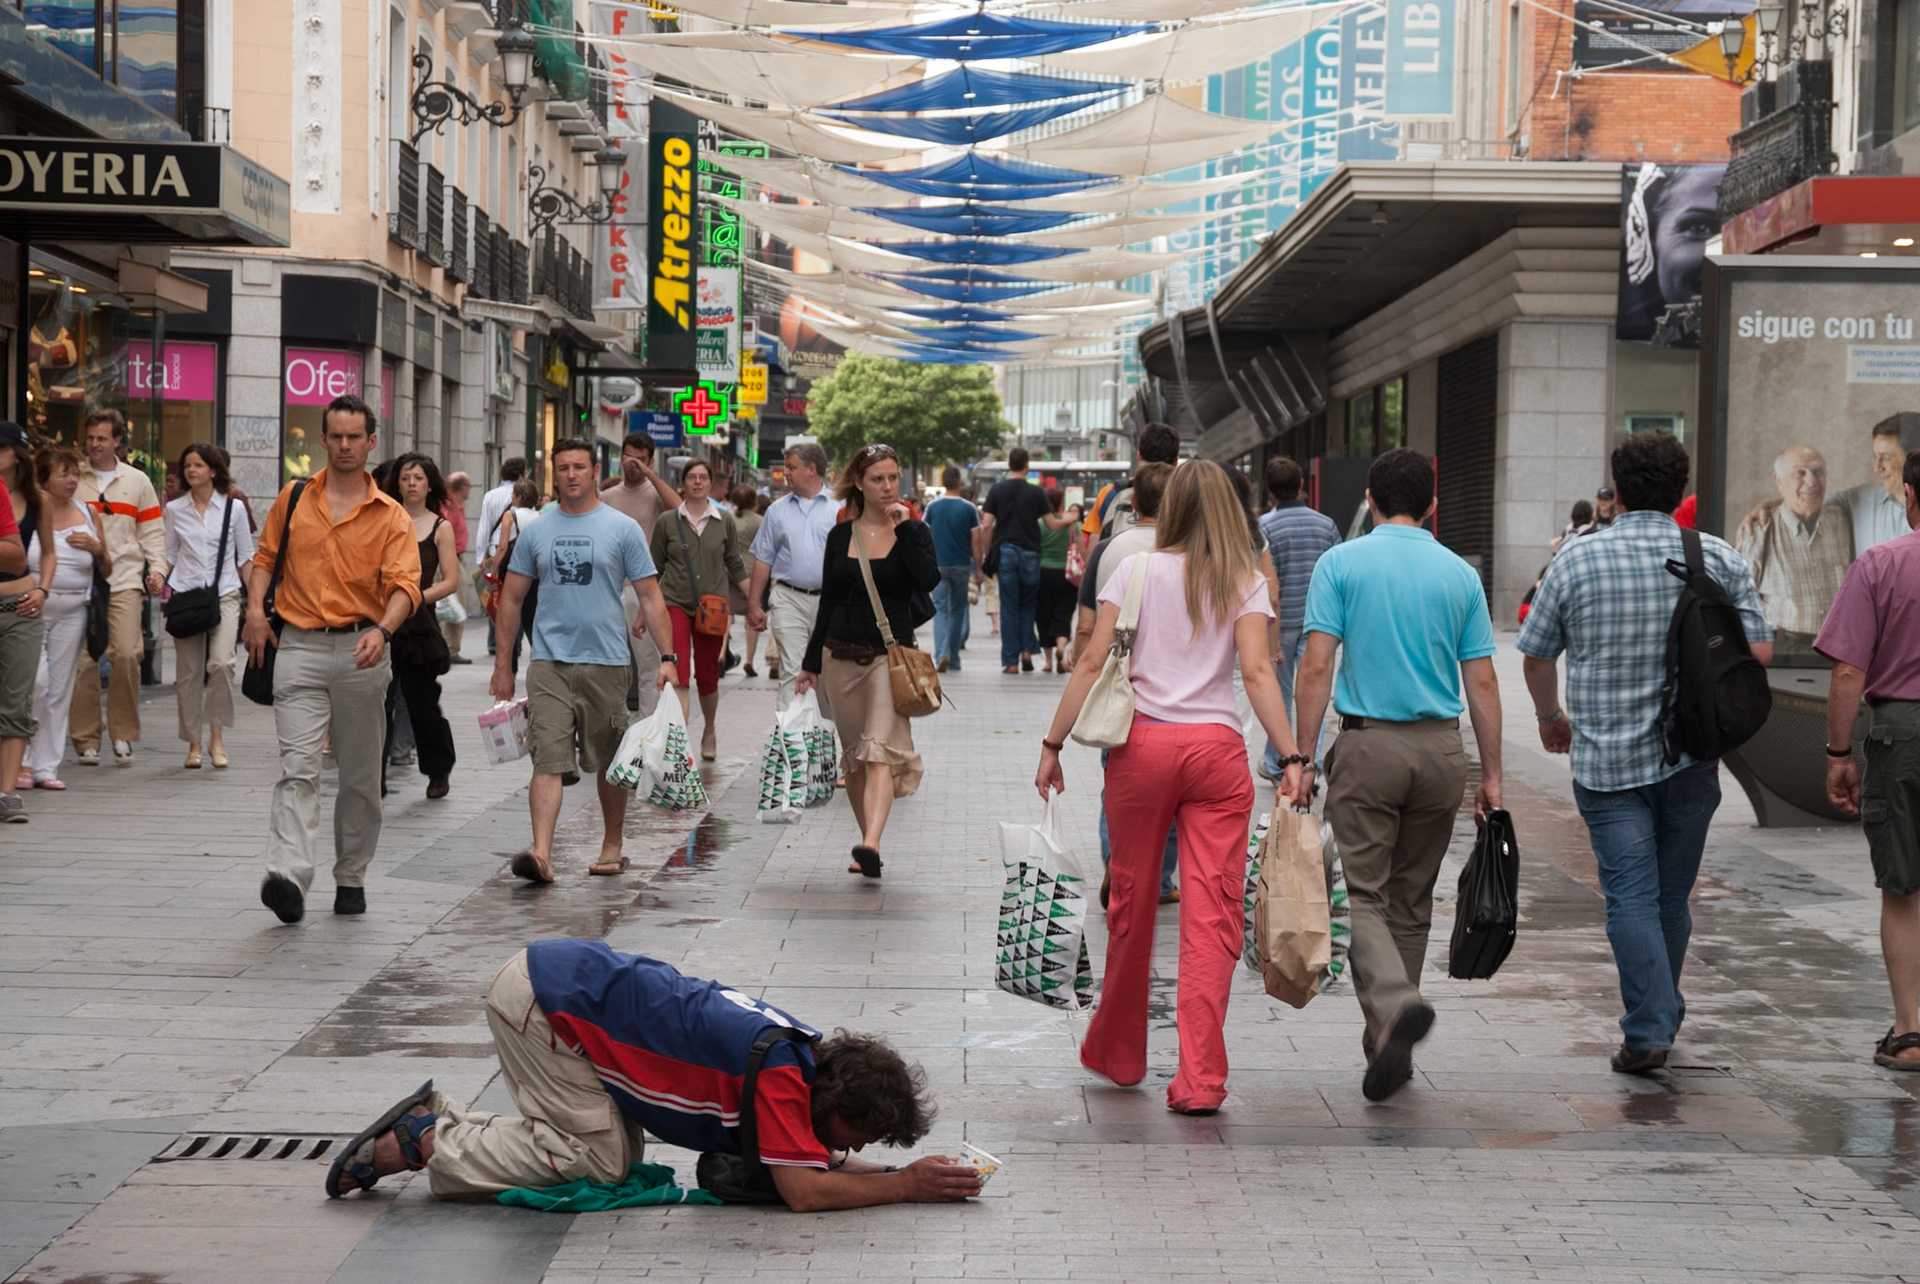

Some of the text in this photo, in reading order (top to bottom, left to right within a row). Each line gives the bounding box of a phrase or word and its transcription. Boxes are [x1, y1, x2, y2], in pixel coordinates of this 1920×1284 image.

[654, 138, 691, 331] Atrezzo
[1738, 310, 1913, 344] sigue con tu
[171, 353, 181, 391] Especial
[646, 422, 675, 432] Phone
[653, 413, 669, 422] The
